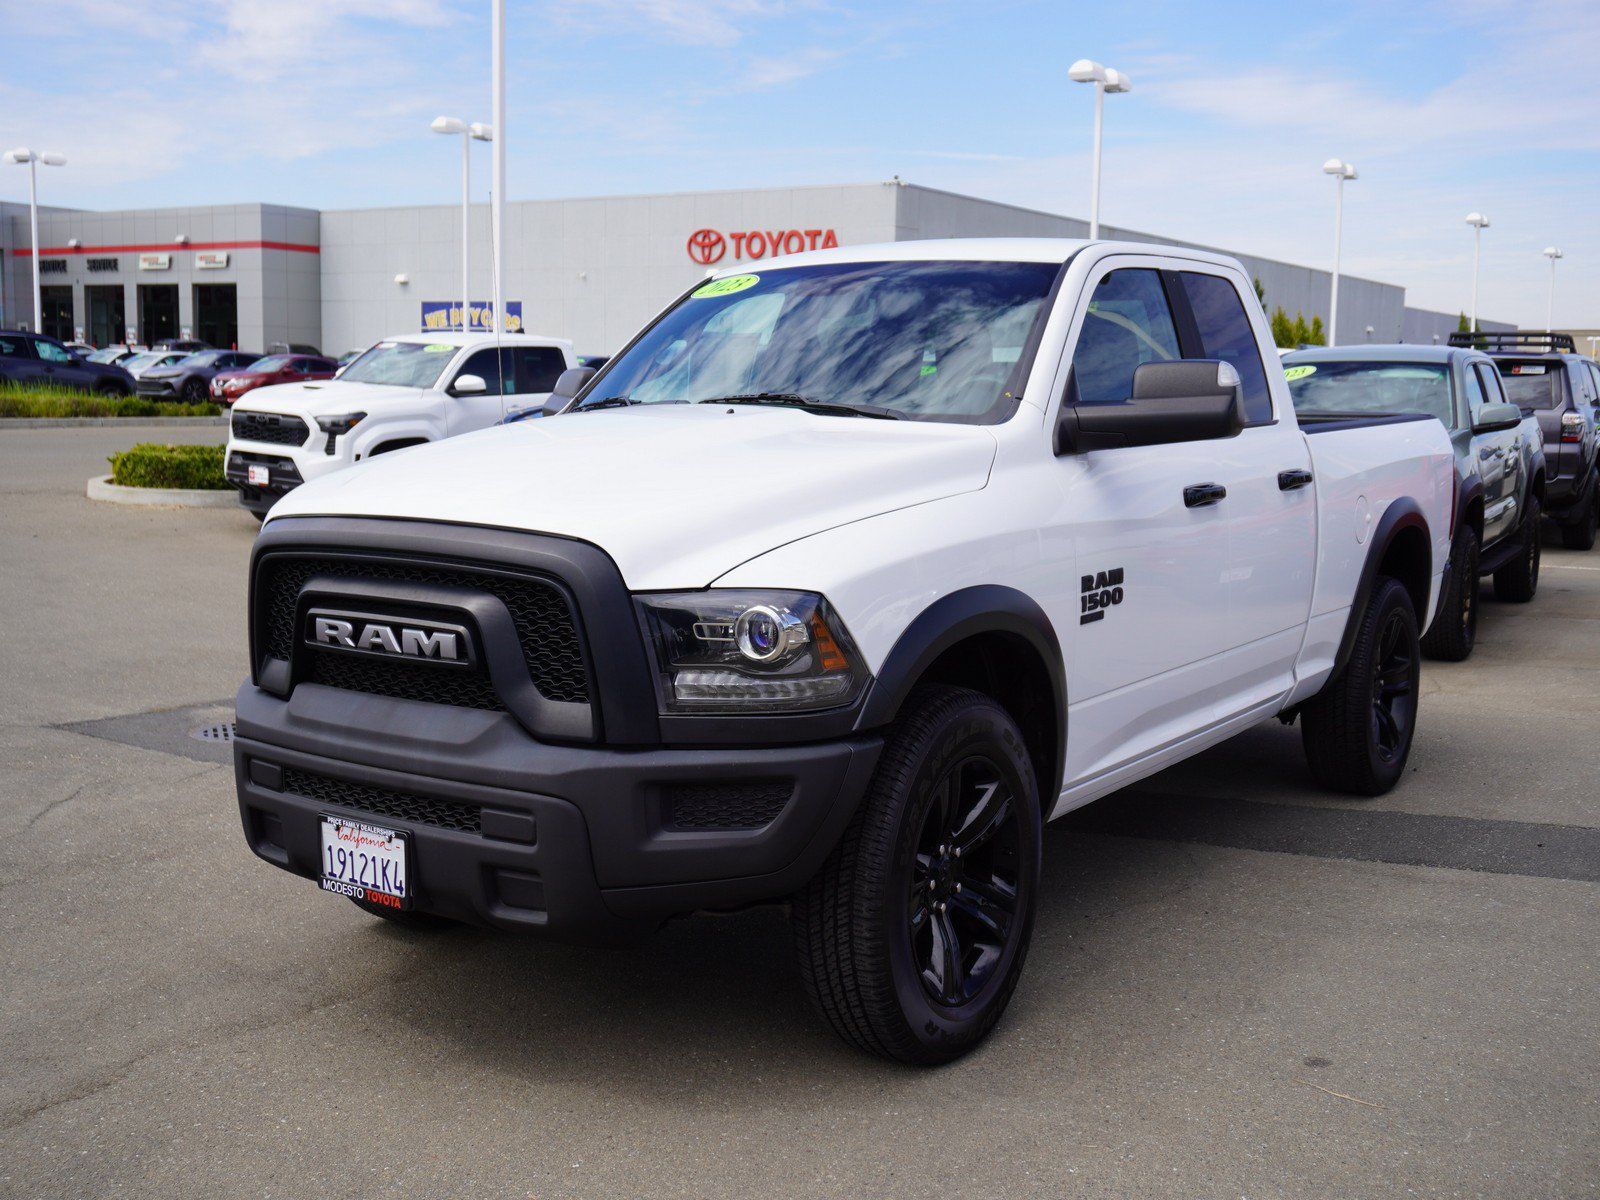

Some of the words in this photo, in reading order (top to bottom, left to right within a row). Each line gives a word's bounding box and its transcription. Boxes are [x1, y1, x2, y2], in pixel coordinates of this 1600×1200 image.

[729, 229, 839, 260] TOYOTA
[38, 258, 68, 274] ERVICE
[424, 308, 448, 328] WE
[1284, 366, 1308, 379] 023
[1081, 566, 1124, 594] RAM
[1080, 586, 1124, 613] 1500
[315, 617, 458, 660] RAM
[327, 816, 342, 826] PRICE
[342, 820, 360, 830] FAMILY
[337, 824, 391, 851] California
[326, 844, 404, 896] 19121K4
[322, 878, 364, 899] MODESTO
[365, 888, 401, 909] TOYOTA
